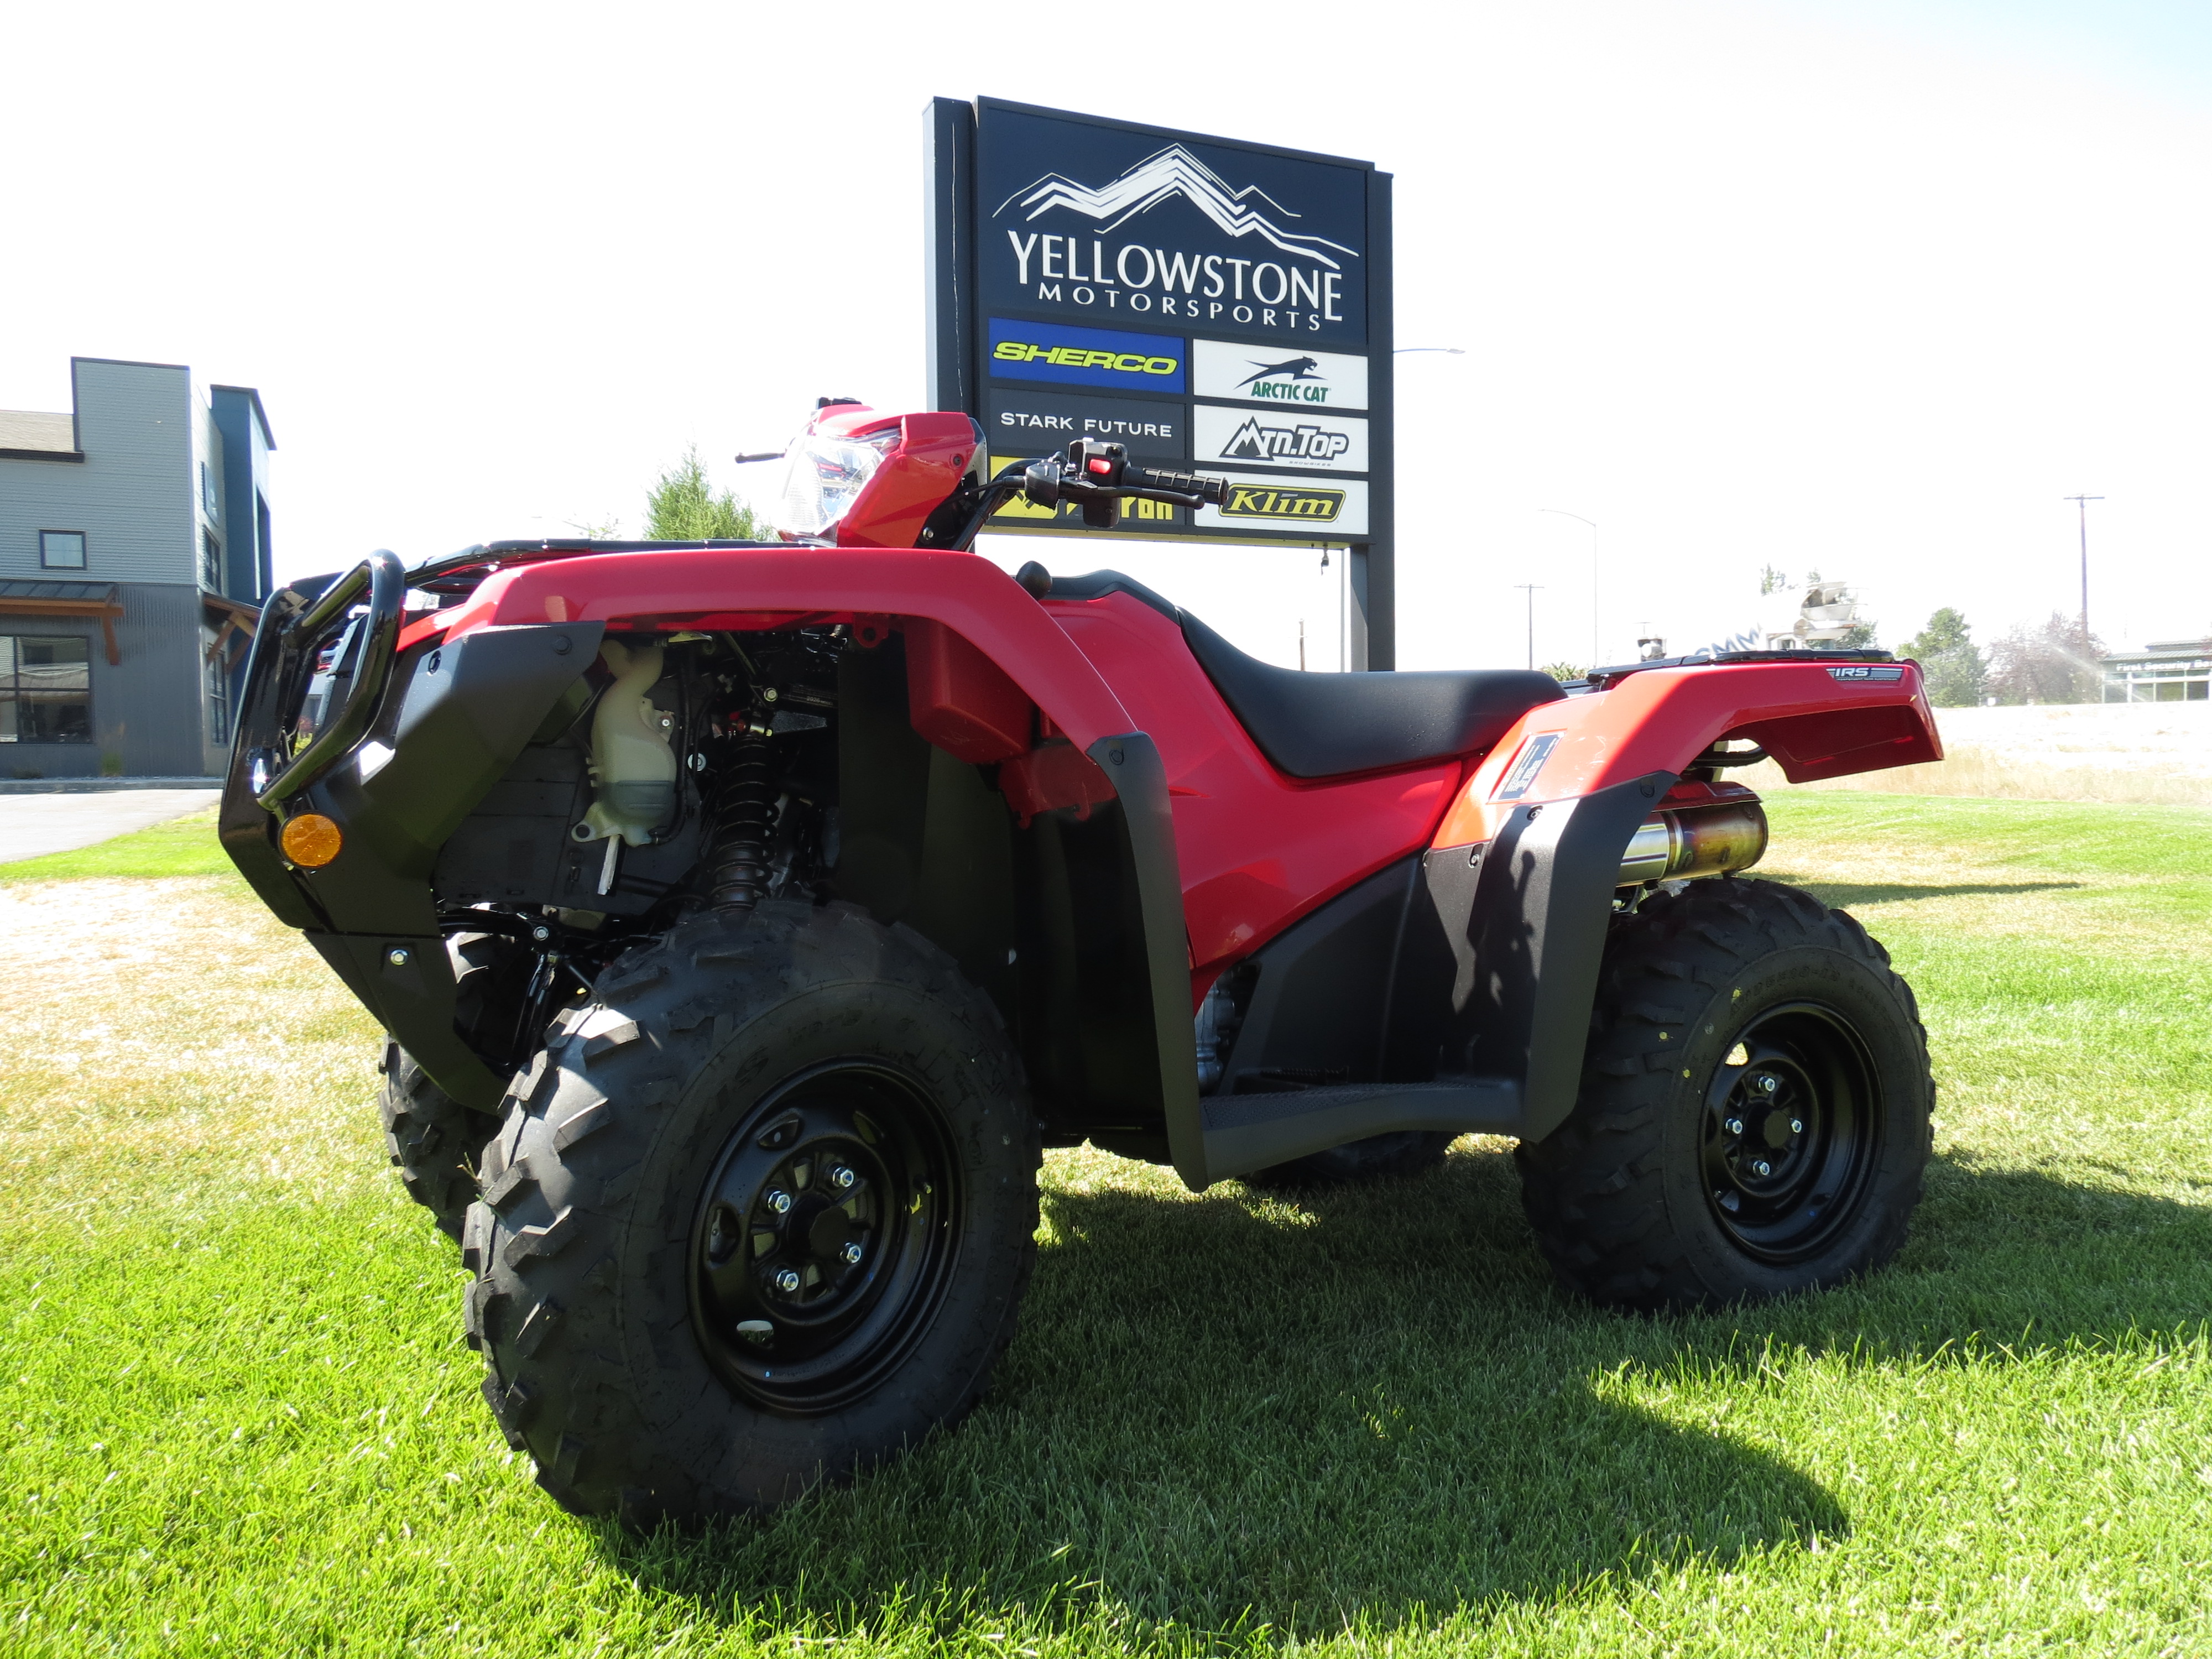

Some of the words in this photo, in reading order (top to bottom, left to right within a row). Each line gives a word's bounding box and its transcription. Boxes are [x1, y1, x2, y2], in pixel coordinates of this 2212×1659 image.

[1007, 229, 1343, 321] YELLOWSTONE
[1038, 283, 1321, 331] MOTORSPORTS
[993, 341, 1178, 375] SHERCO
[1251, 381, 1301, 400] ARCTIC
[1303, 386, 1328, 403] CAT
[1000, 412, 1073, 430] STARK
[1084, 419, 1172, 437] FUTURE
[1227, 490, 1334, 515] Klim
[1835, 667, 1869, 677] IRS
[2116, 663, 2142, 671] First
[2144, 661, 2191, 671] Security
